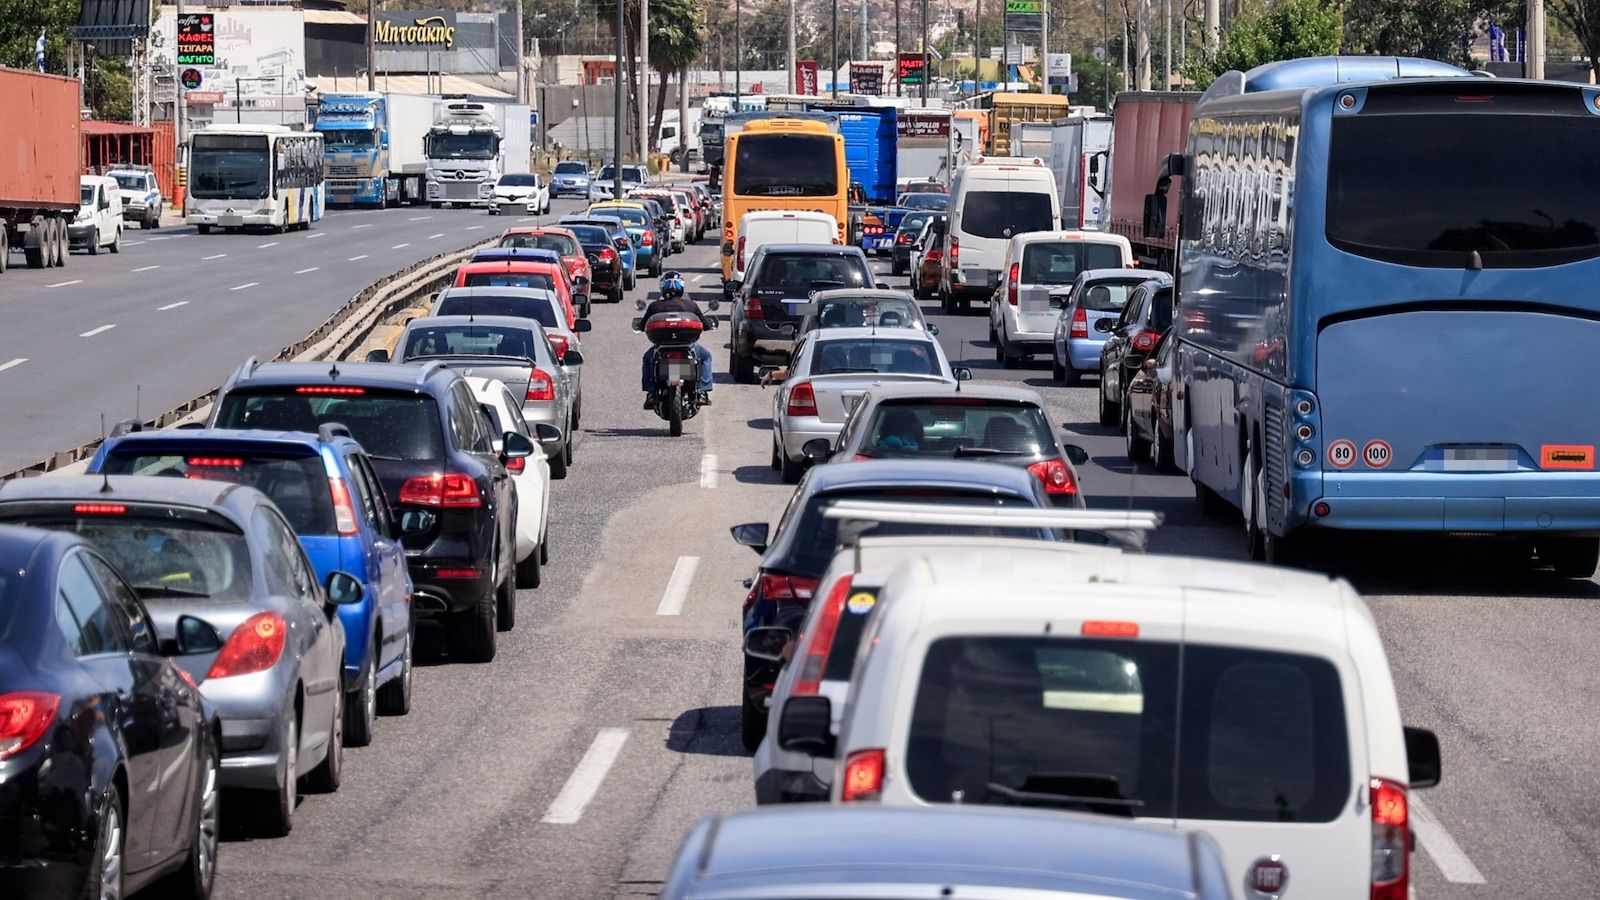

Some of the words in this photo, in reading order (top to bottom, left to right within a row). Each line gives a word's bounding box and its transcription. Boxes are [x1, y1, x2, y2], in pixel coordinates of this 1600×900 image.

[178, 14, 200, 26] coffee
[178, 33, 213, 42] ΚΑΦΕΣ
[178, 44, 214, 52] ΤΣΙΓΑΡΑ
[178, 55, 214, 63] ΦΑΓΗΤΟ
[184, 70, 198, 80] 24
[767, 185, 804, 195] ISUZU
[1335, 447, 1350, 459] 80
[1368, 447, 1387, 459] 100
[1256, 867, 1282, 887] FIAT
